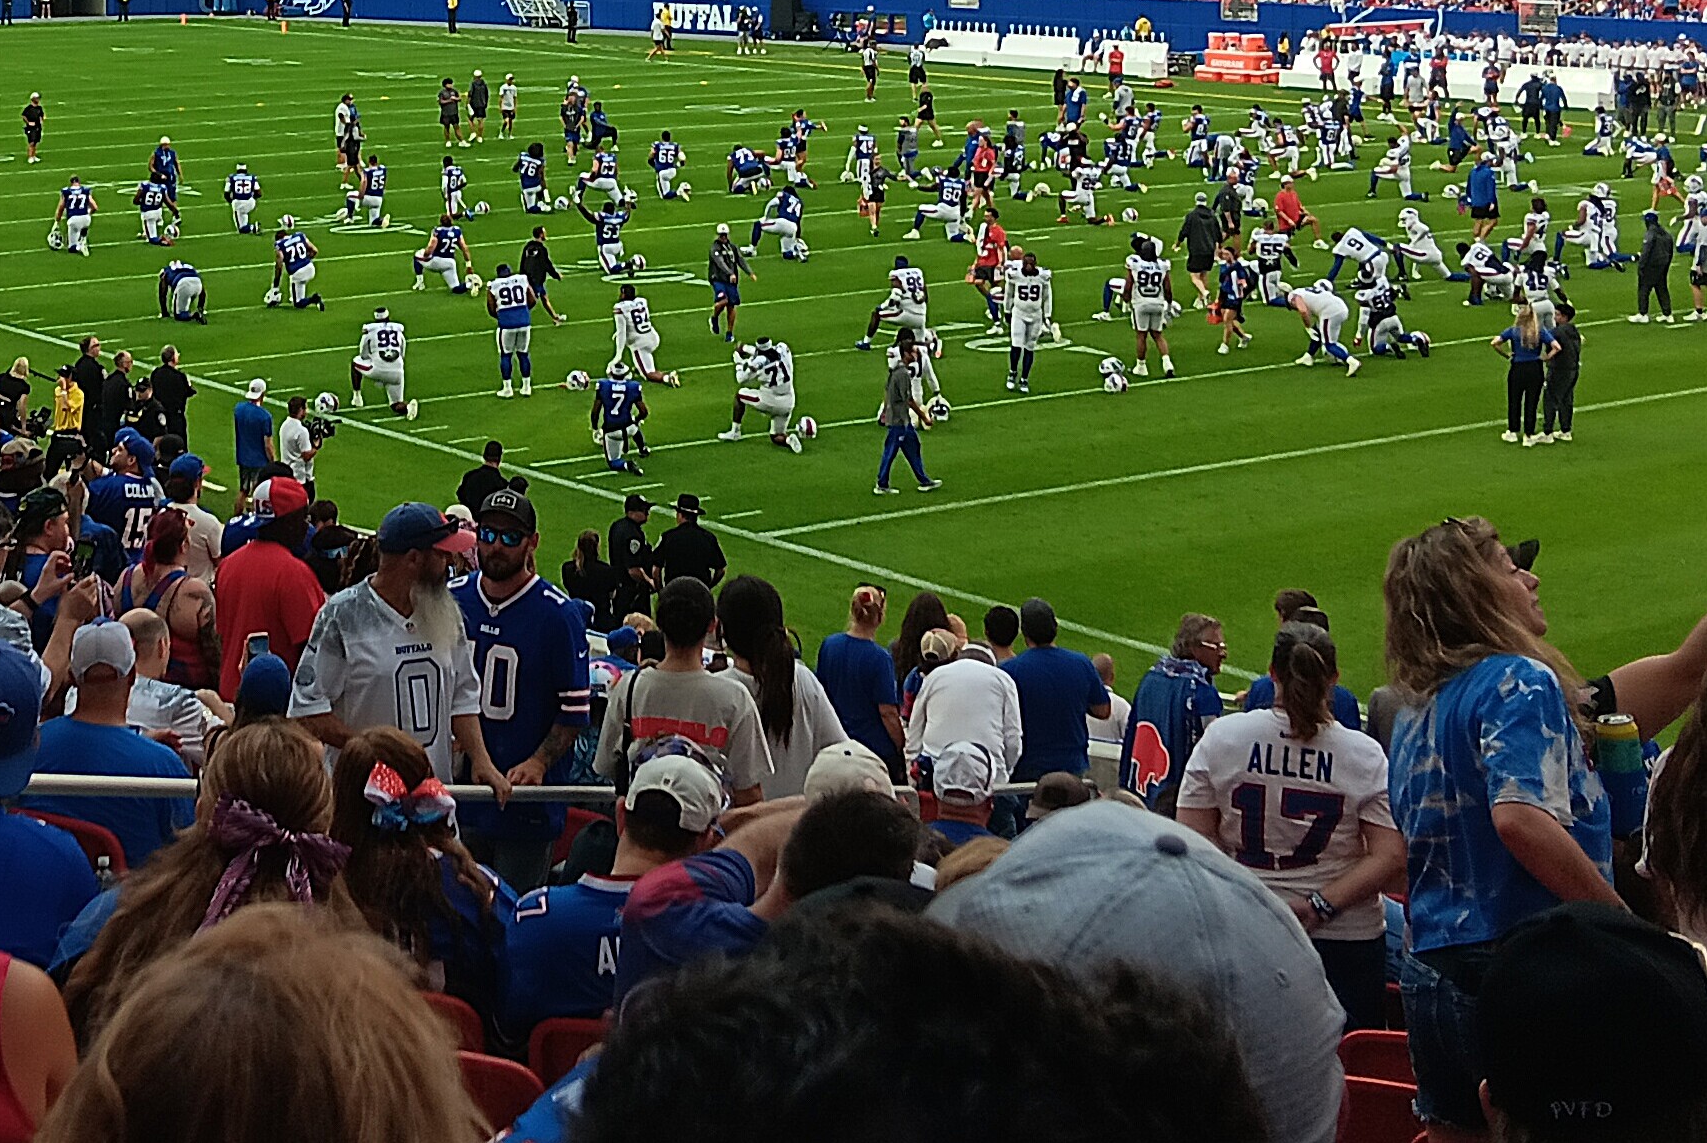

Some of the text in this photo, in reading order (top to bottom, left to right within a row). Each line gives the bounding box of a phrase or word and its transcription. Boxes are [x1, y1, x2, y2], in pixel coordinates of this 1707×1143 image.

[653, 2, 738, 32] UFFAL
[658, 149, 675, 164] 66
[521, 162, 536, 176] 76
[69, 194, 86, 209] 77
[943, 187, 962, 202] 60
[286, 242, 306, 262] 70
[440, 238, 457, 253] 75
[498, 285, 526, 306] 90
[1018, 284, 1040, 301] 59
[377, 329, 399, 347] 93
[764, 362, 790, 387] 71
[610, 393, 624, 415] 7
[122, 507, 153, 549] 15
[395, 643, 433, 656] BUFFALO
[395, 657, 441, 747] 0
[1247, 742, 1333, 783] ALLEN
[1231, 782, 1345, 870] 17
[1550, 1101, 1613, 1119] PVFD
